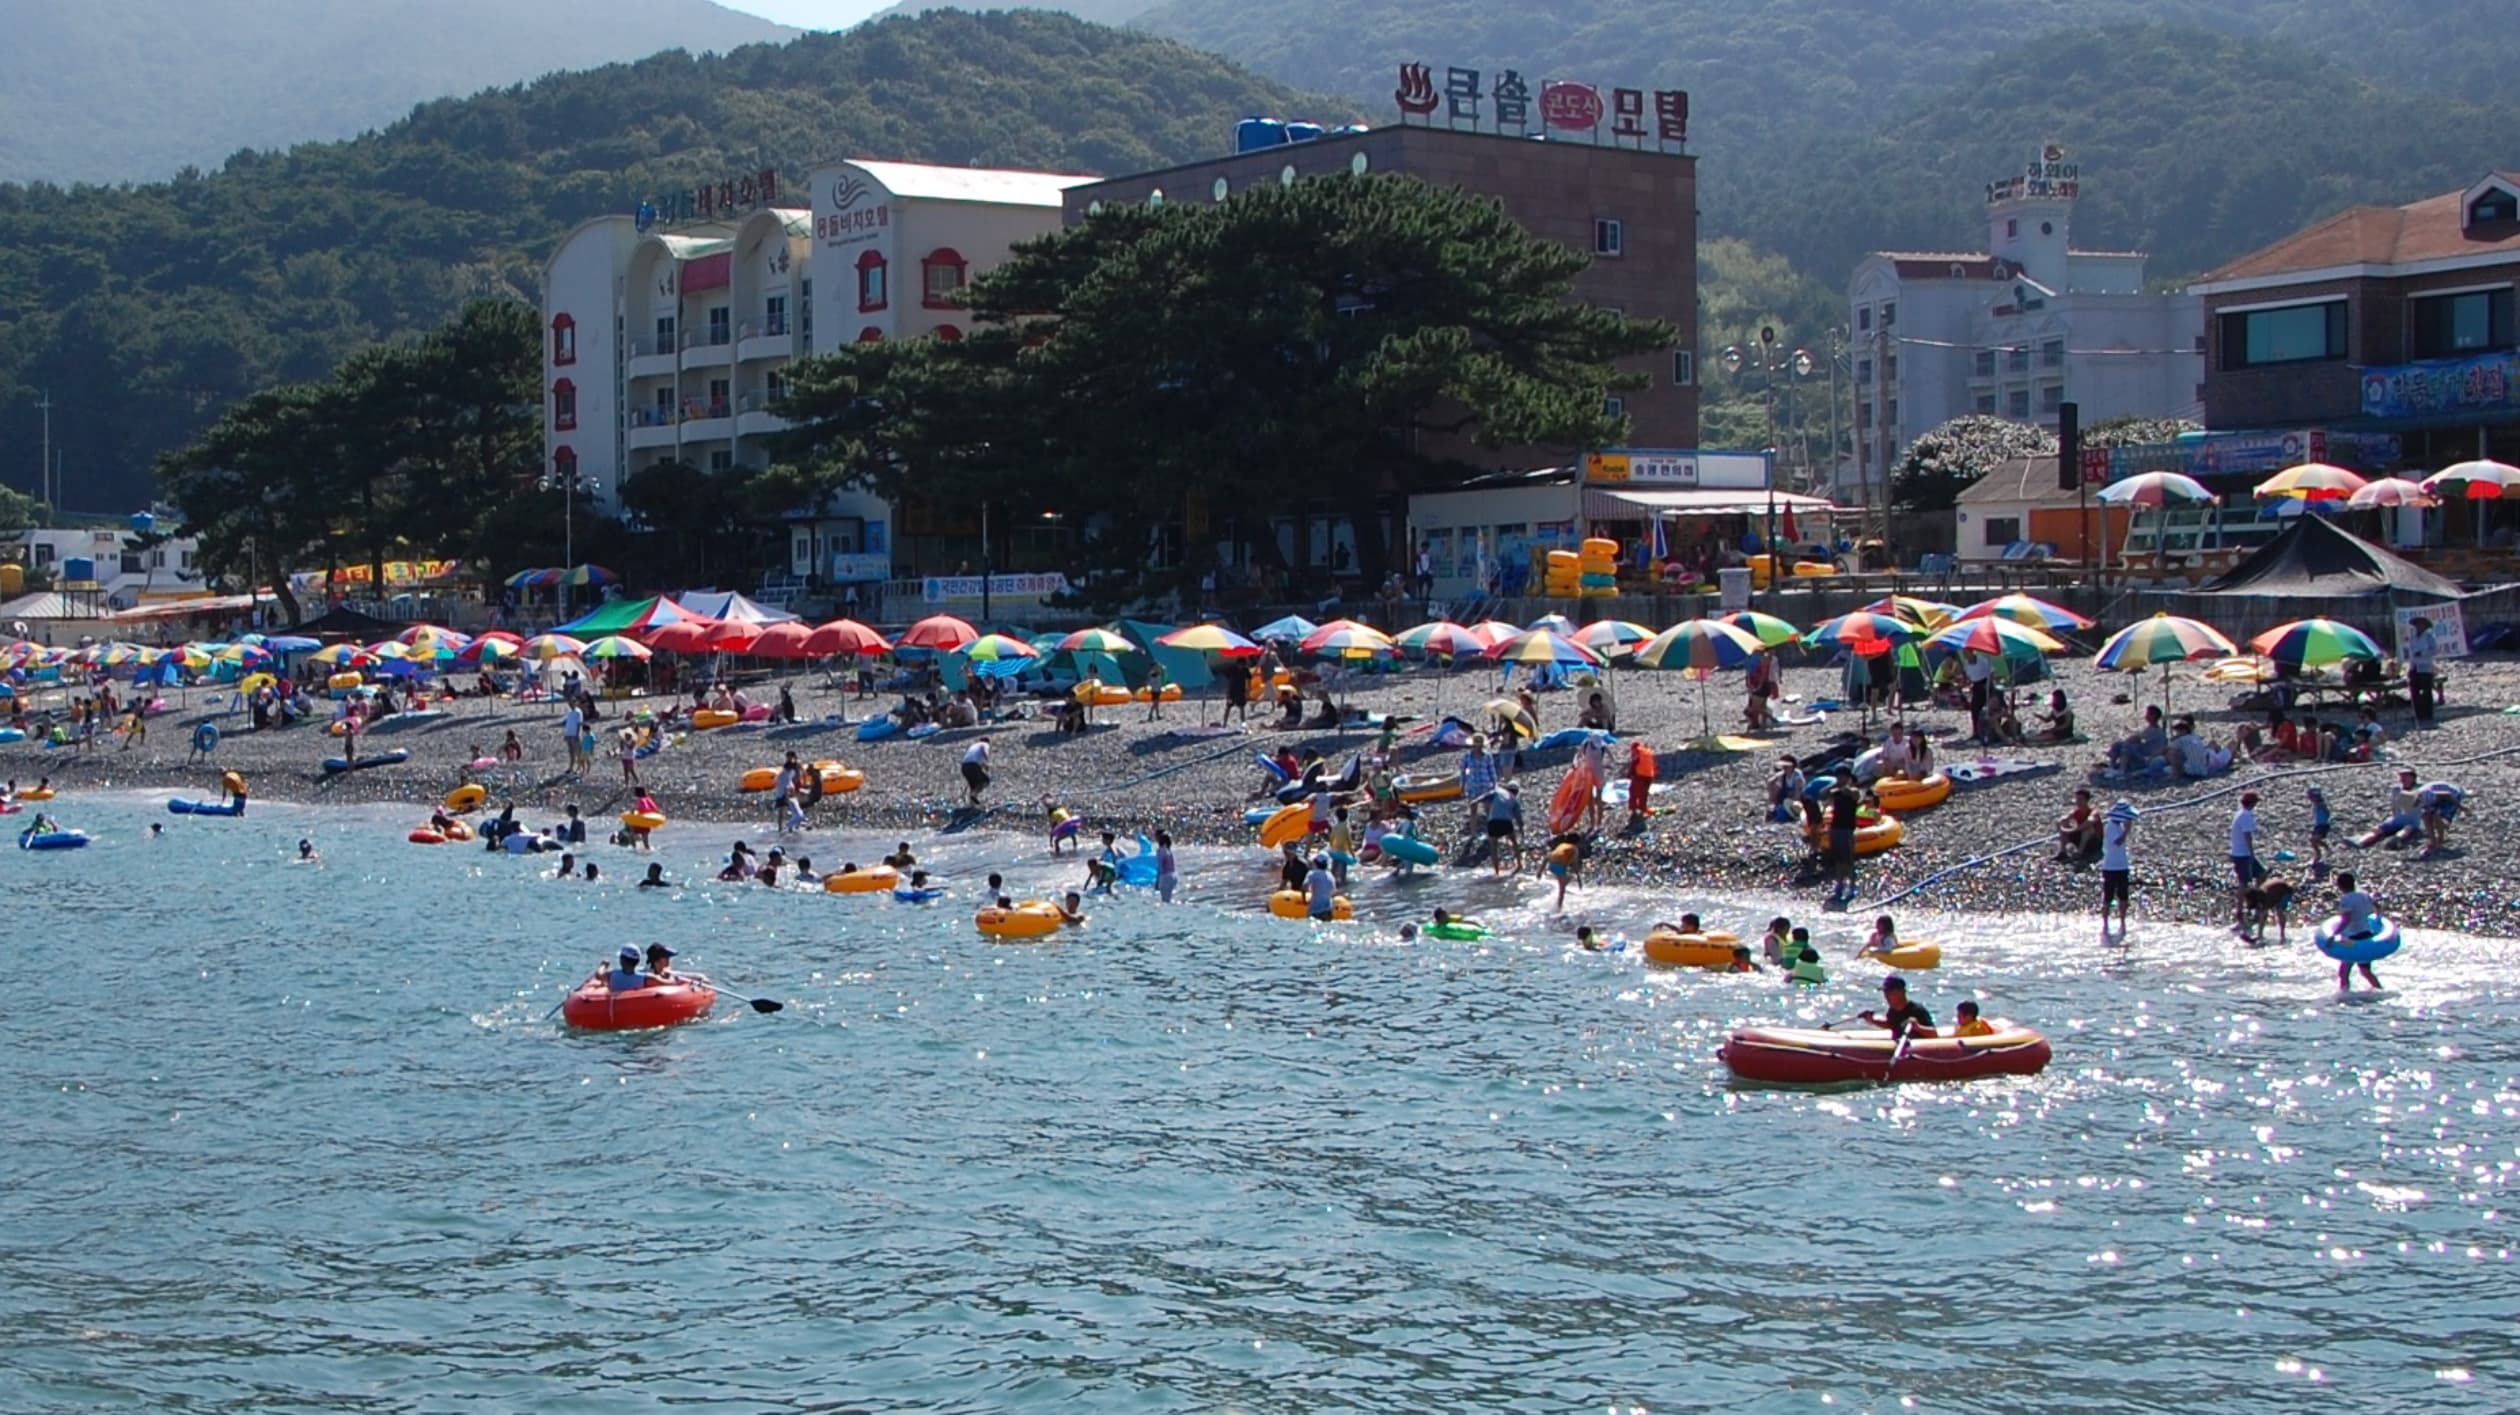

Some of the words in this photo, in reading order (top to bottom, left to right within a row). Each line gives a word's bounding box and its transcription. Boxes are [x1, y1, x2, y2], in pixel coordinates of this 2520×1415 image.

[1443, 66, 1532, 124] 큰솔
[1545, 91, 1600, 120] 콘도식
[1611, 87, 1689, 142] 모텔
[2027, 162, 2079, 180] 하와이
